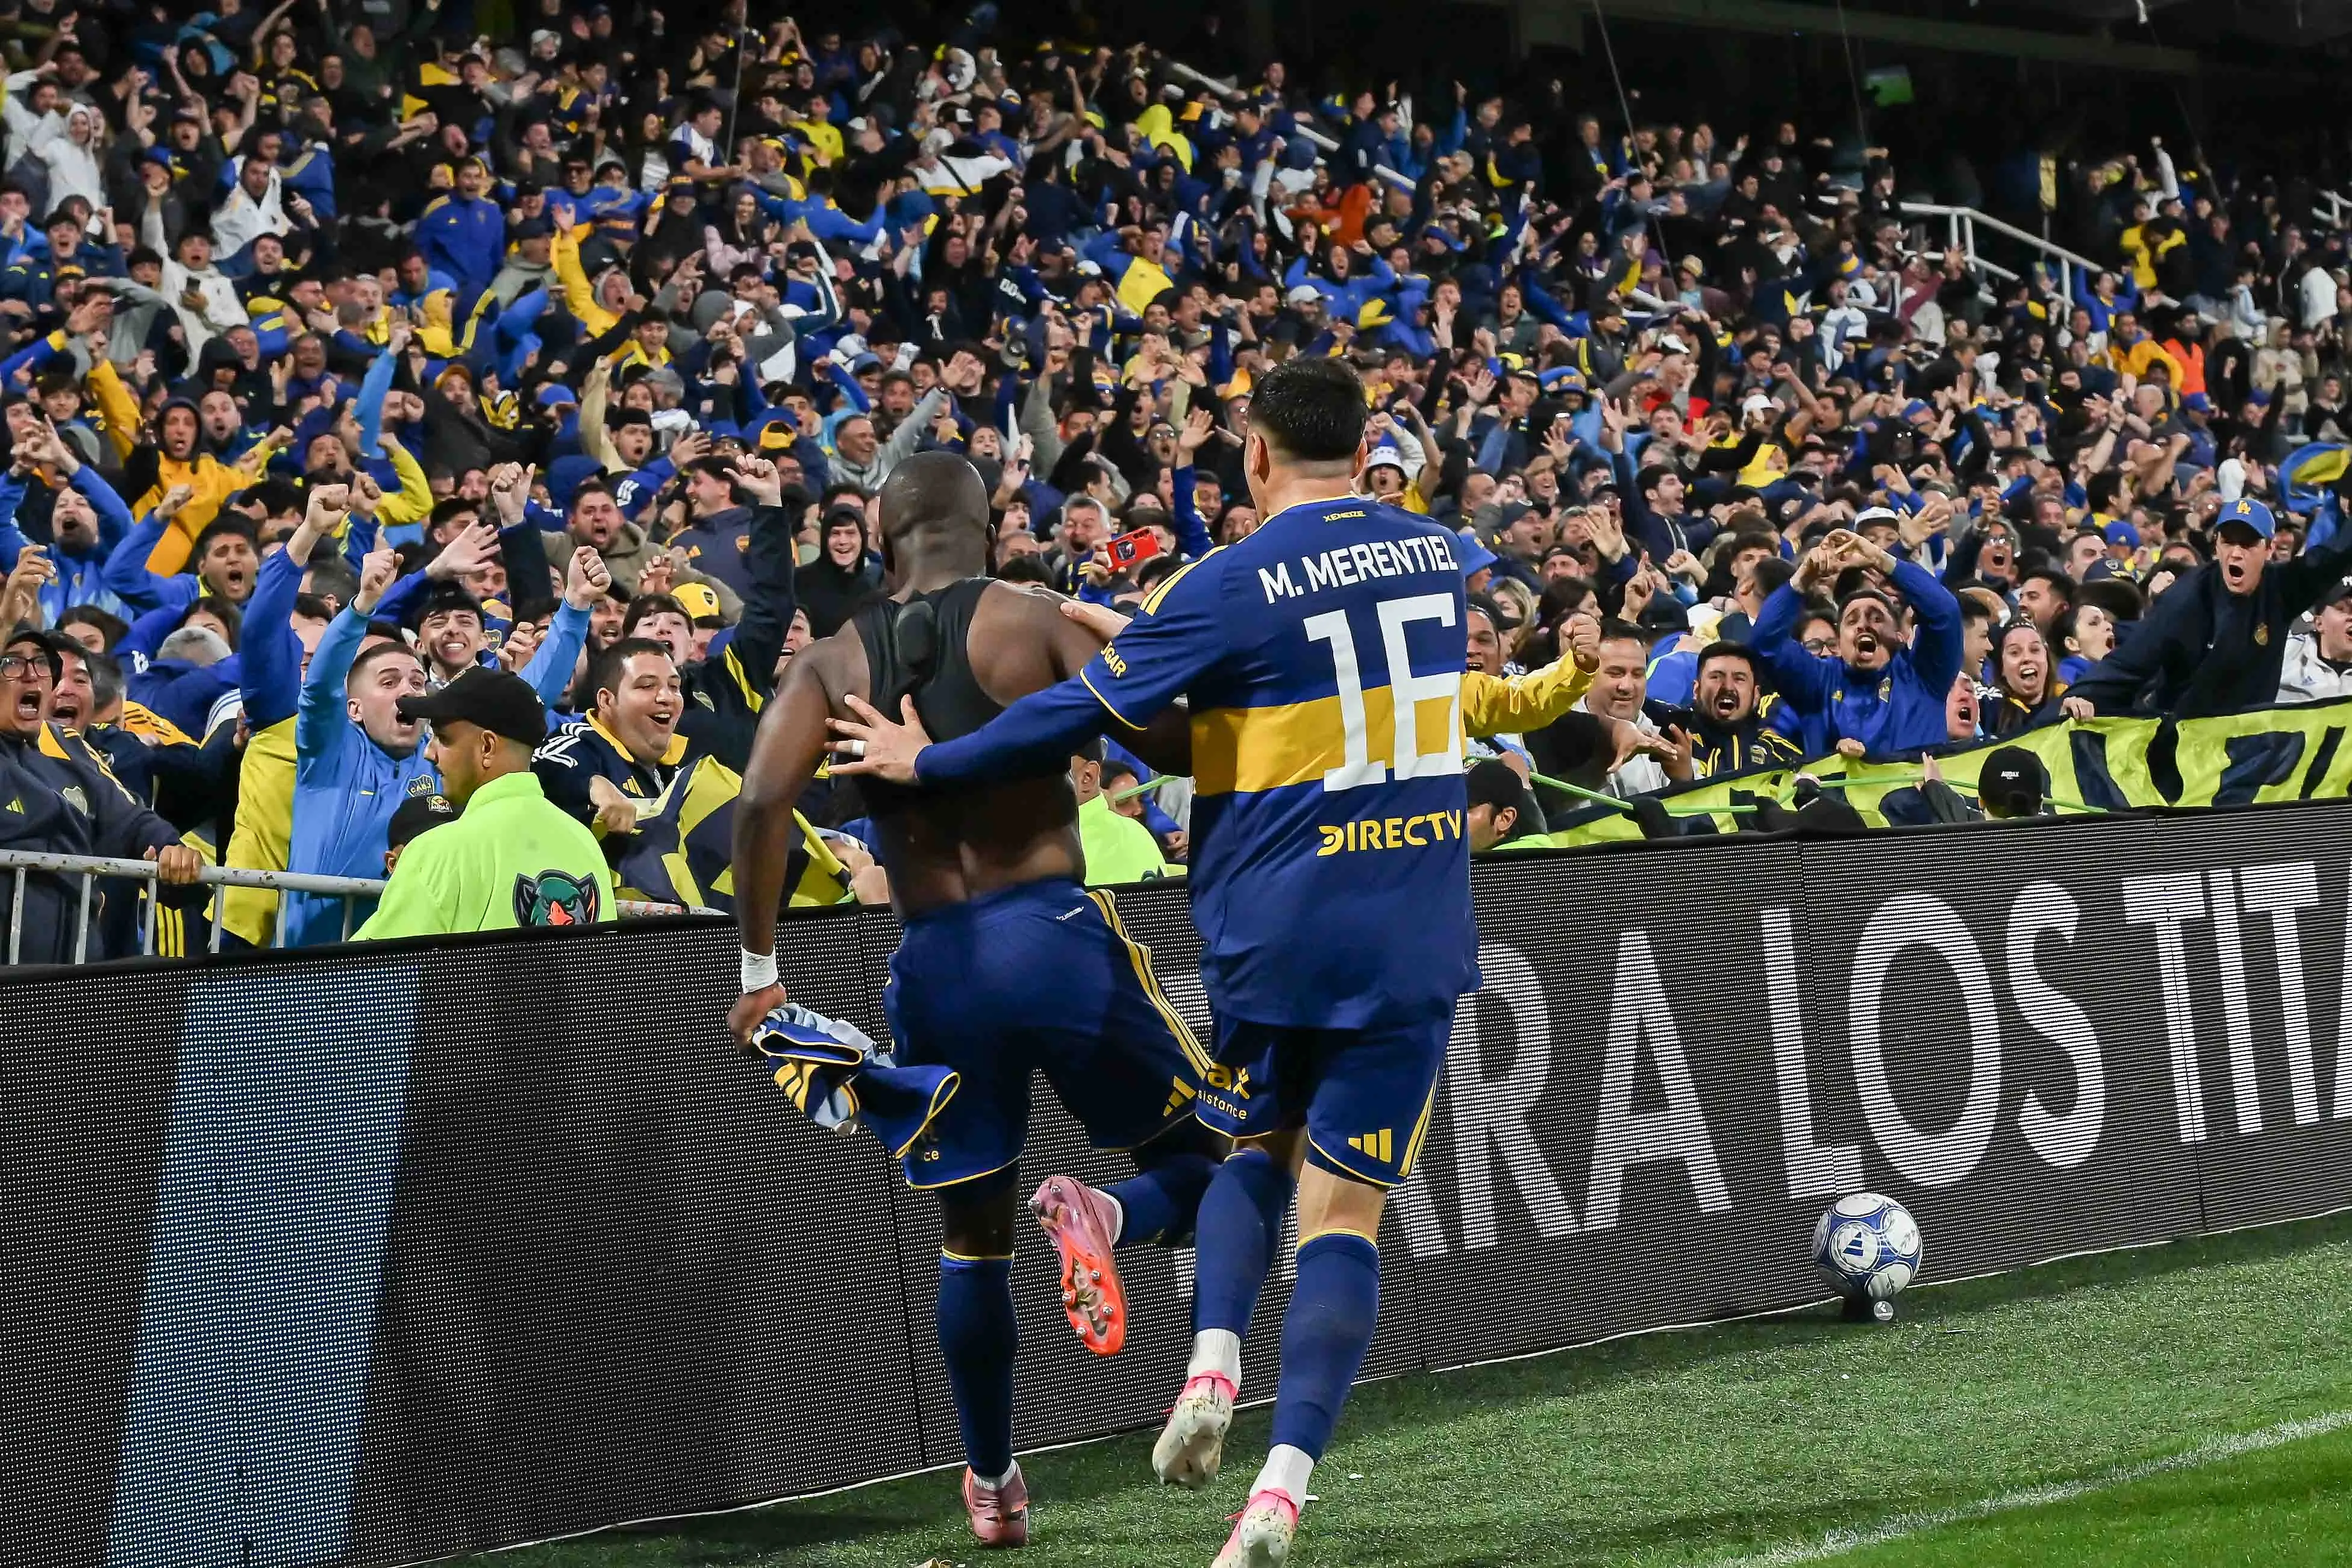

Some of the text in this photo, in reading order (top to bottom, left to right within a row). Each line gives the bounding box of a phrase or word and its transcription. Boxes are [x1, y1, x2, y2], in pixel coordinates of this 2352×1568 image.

[1258, 535, 1459, 604] M. MERENTIEL
[1303, 592, 1463, 792] 16
[1316, 808, 1461, 857] DIRECTV
[1760, 879, 2106, 1199] LOS
[2122, 858, 2352, 1143] TIT
